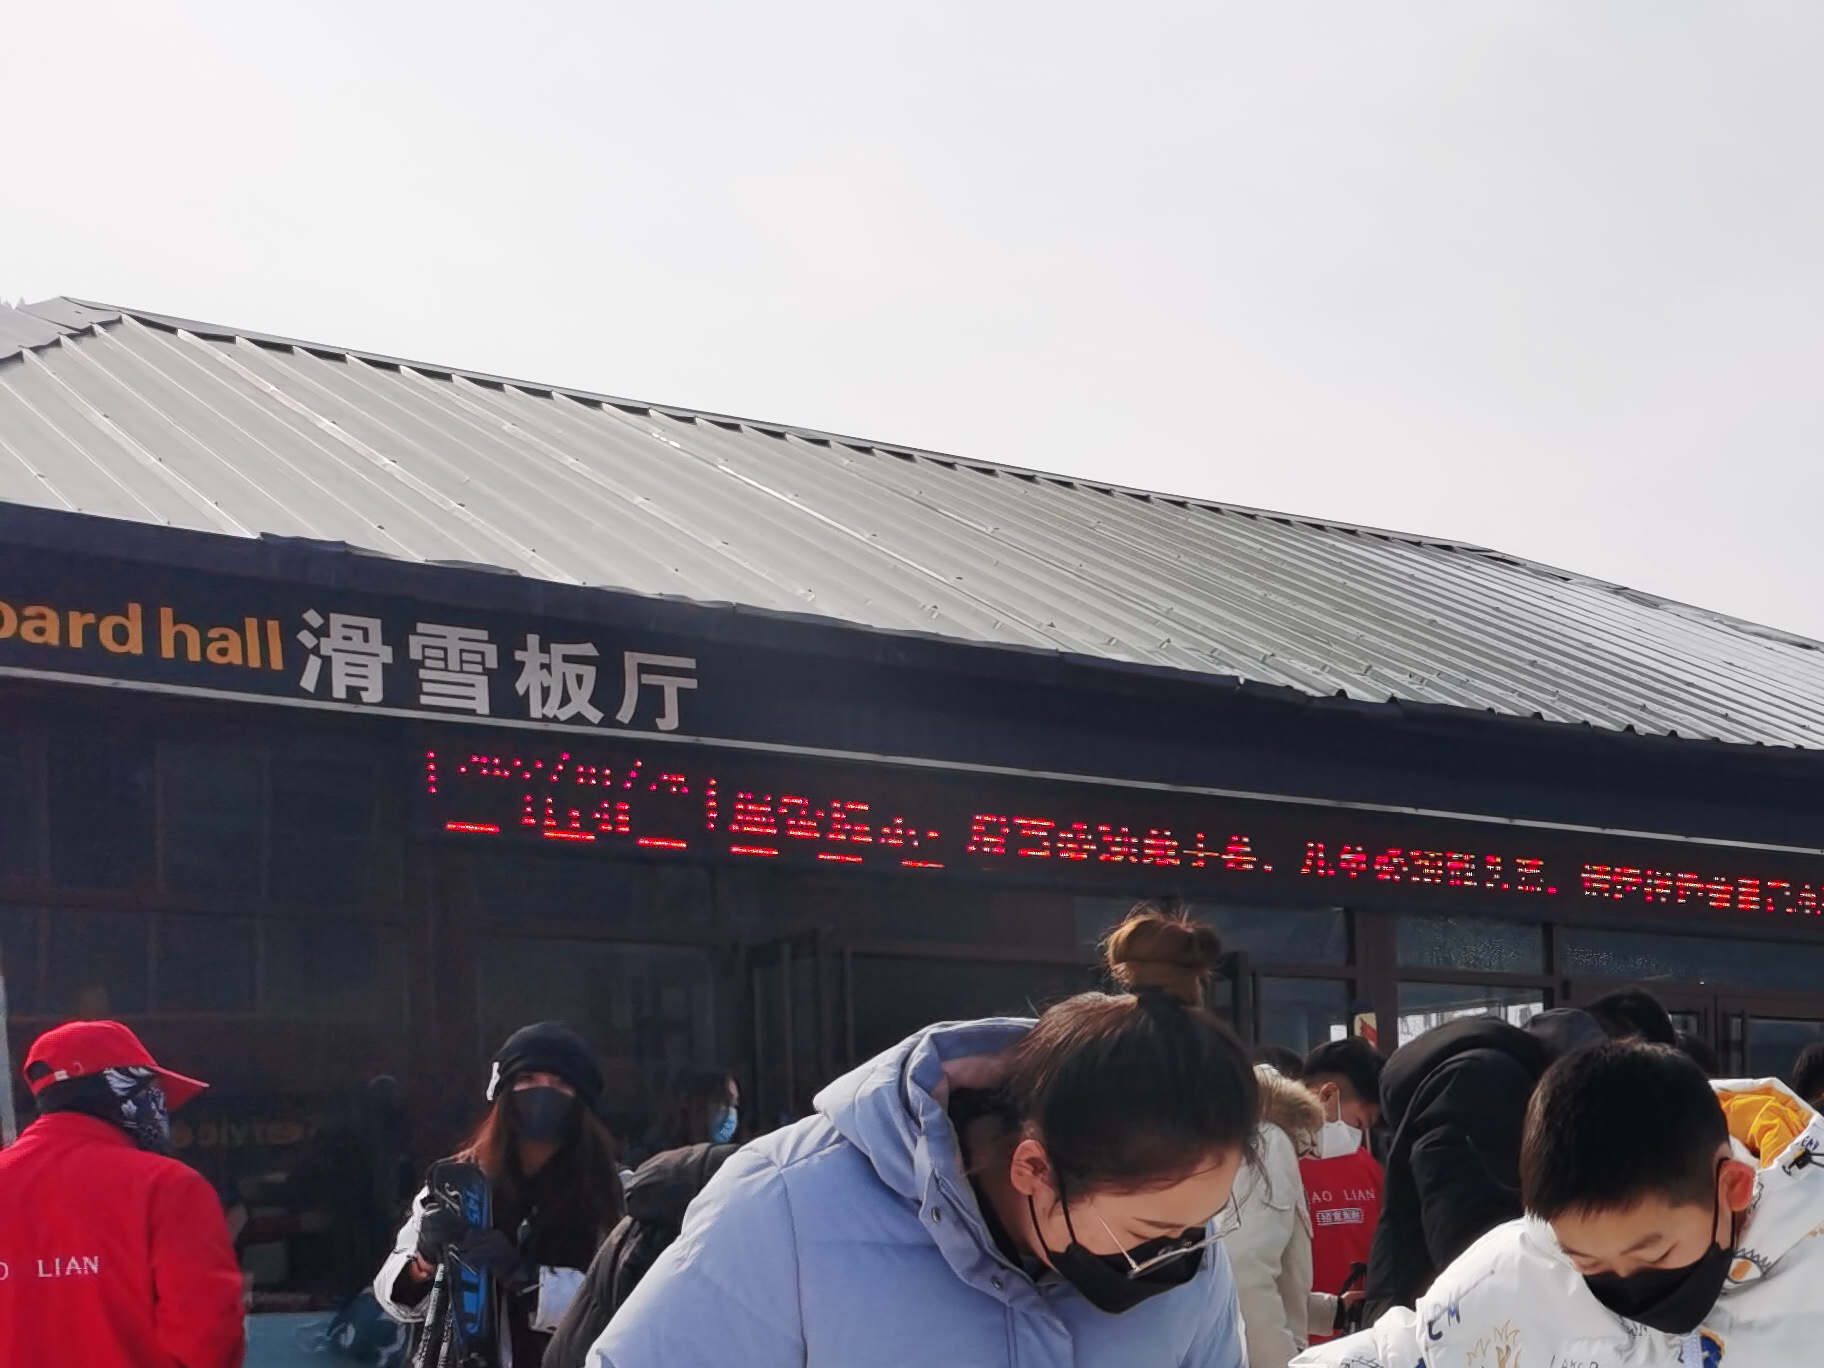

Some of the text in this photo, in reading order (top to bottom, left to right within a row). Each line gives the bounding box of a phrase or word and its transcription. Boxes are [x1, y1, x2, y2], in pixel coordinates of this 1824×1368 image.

[159, 606, 284, 670] hall
[296, 608, 699, 731] 滑雪板厅
[1342, 1187, 1376, 1201] LIAN
[37, 1255, 99, 1278] LIAN
